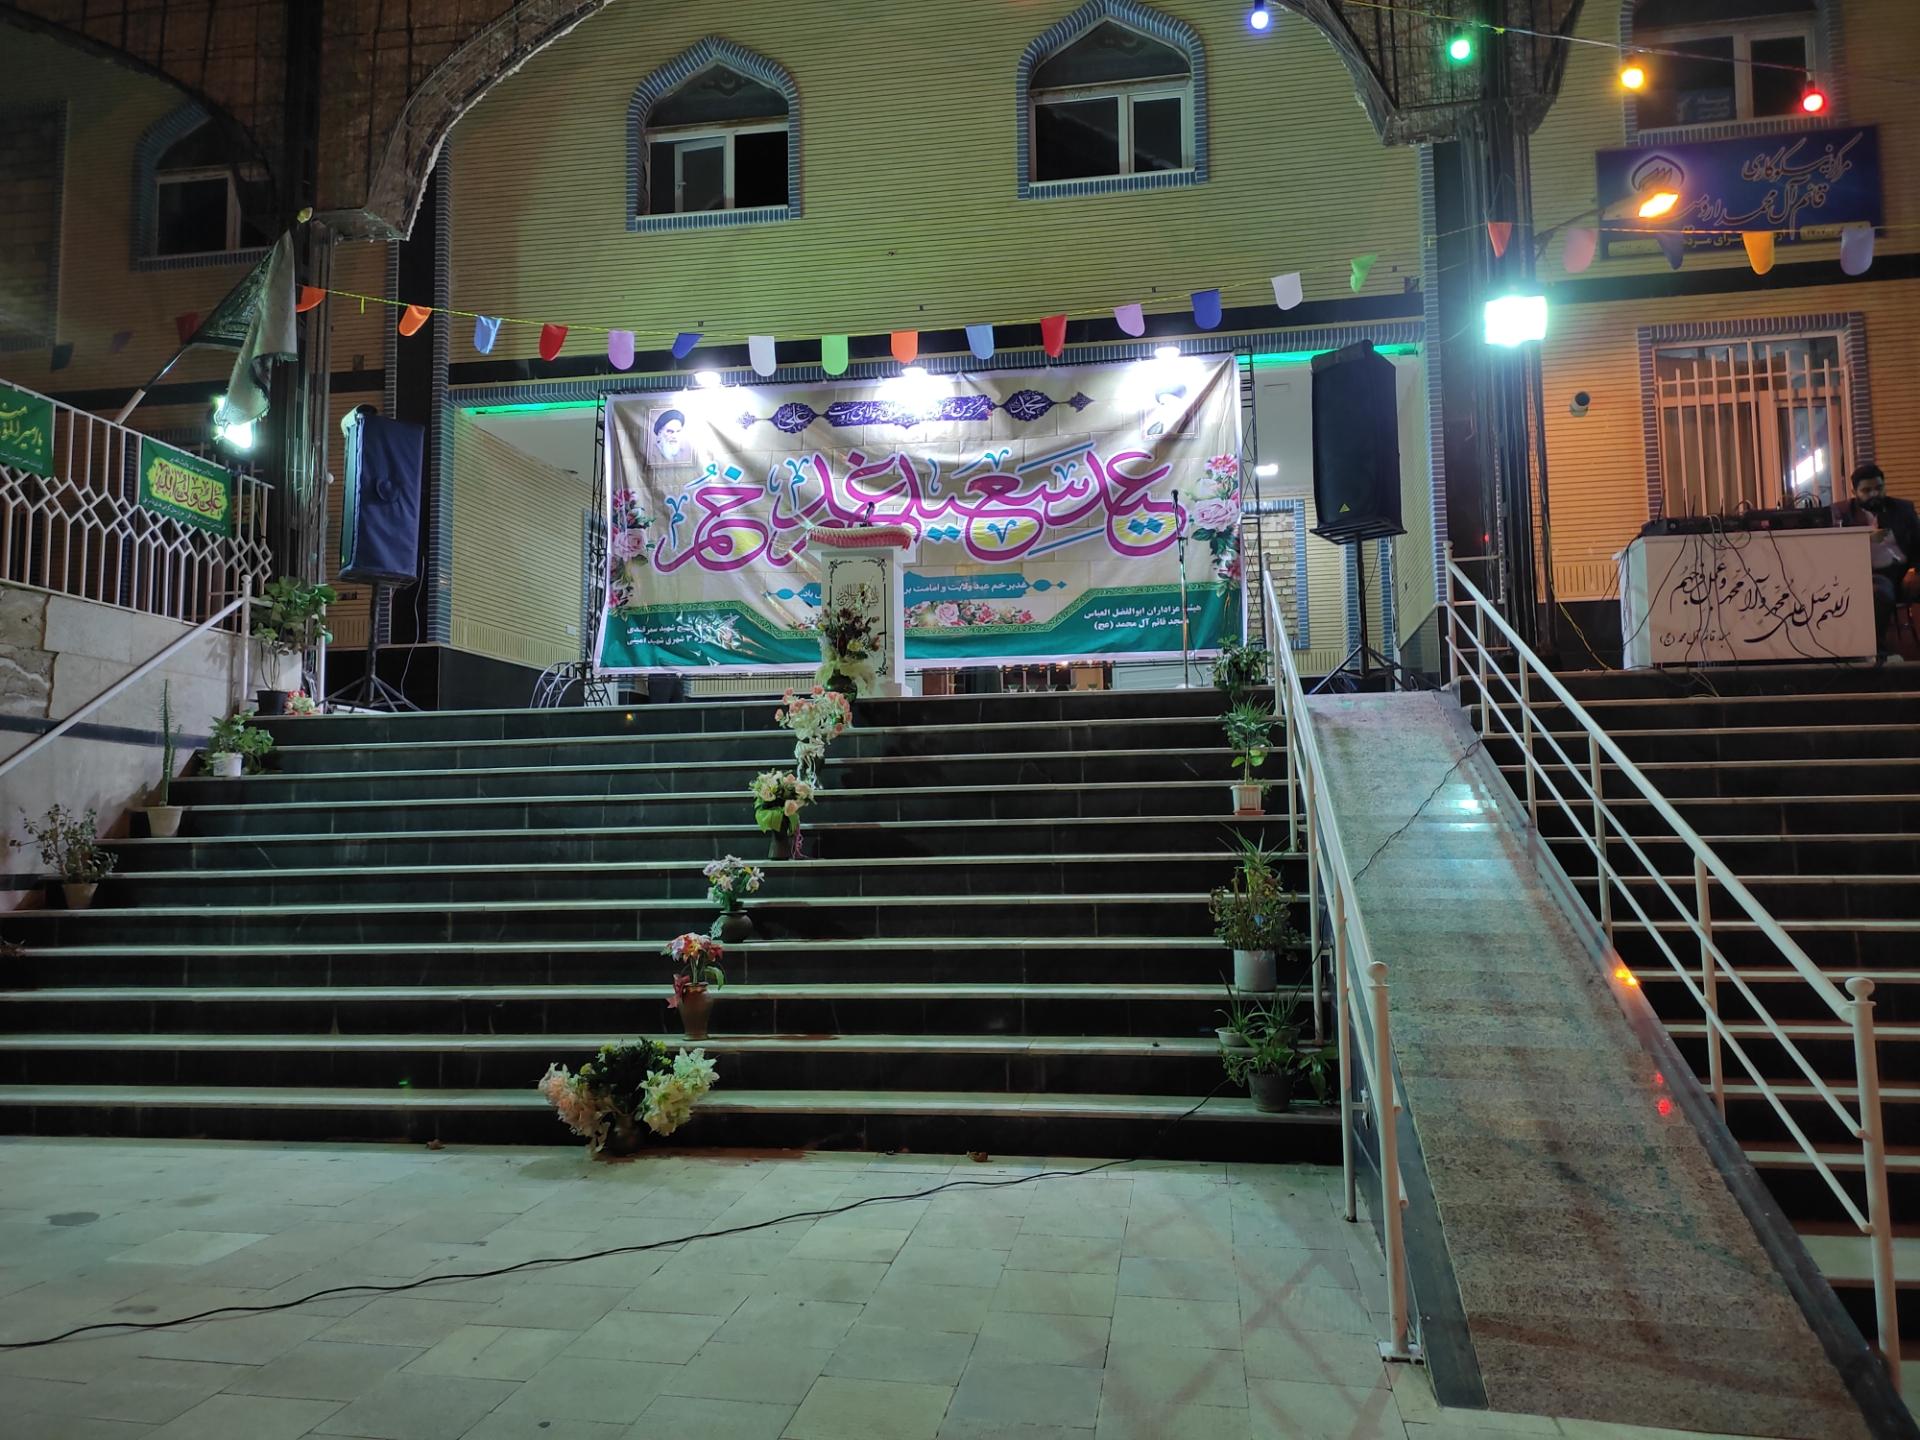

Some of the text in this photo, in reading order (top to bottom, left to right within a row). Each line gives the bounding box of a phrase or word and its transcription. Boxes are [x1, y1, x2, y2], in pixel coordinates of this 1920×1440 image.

[1742, 137, 1834, 182] نیکوکاری
[1714, 189, 1778, 227] محمد
[892, 449, 1090, 562] سعید
[1045, 450, 1188, 557] عید
[664, 463, 768, 571] خم
[1006, 581, 1028, 592] غدیر
[1083, 607, 1110, 619] العباس
[1112, 607, 1145, 618] ابوالفضل
[1147, 605, 1180, 616] عزاداران
[659, 624, 676, 632] شهید
